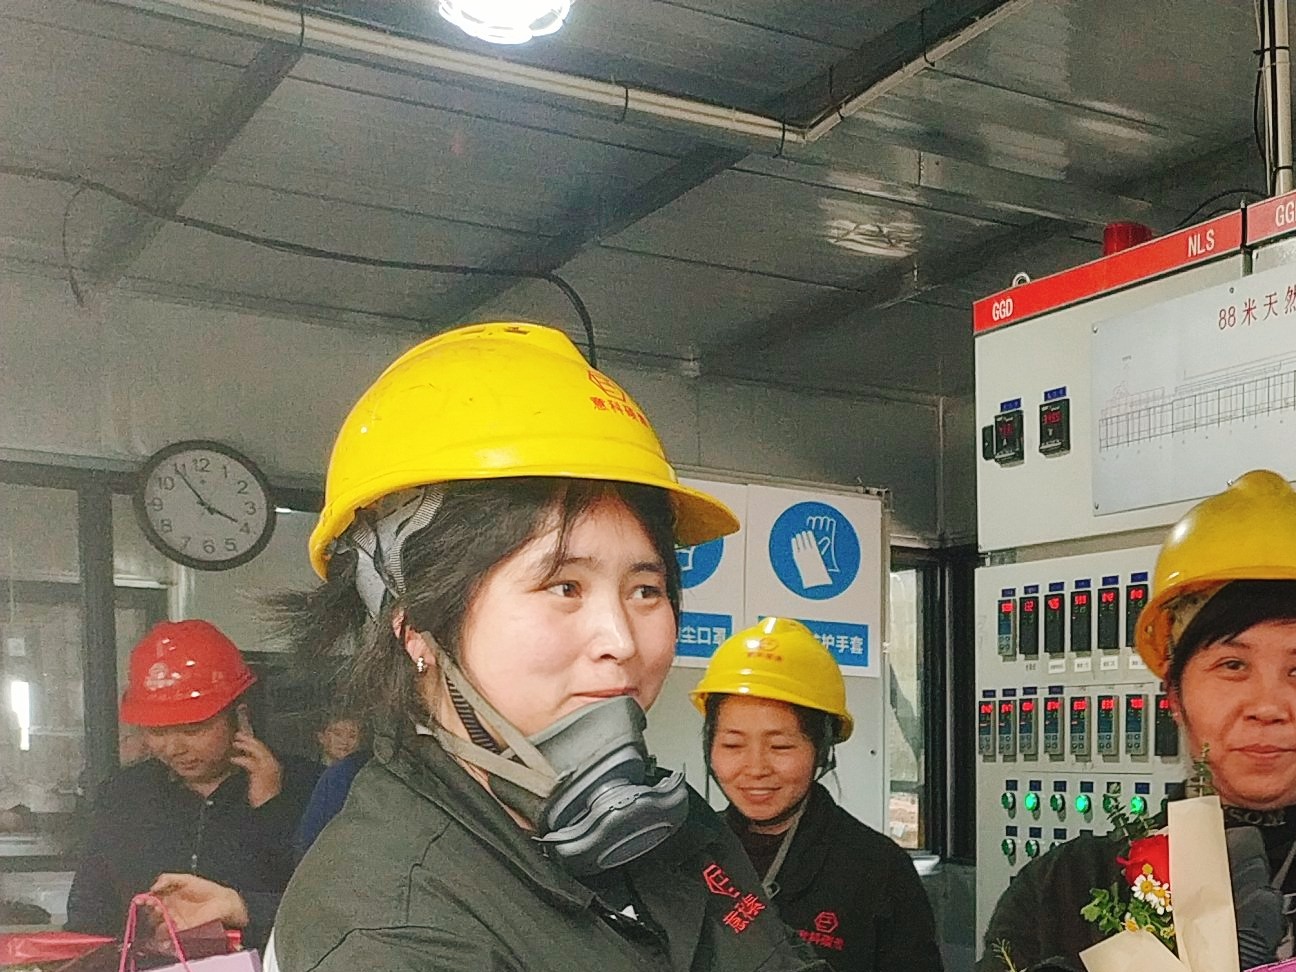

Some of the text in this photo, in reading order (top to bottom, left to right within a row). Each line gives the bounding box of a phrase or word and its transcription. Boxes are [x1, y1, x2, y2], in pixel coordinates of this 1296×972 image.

[1187, 229, 1215, 257] NLS
[991, 298, 1013, 322] GGD
[192, 458, 210, 472] 12
[159, 476, 175, 490] 10
[237, 481, 248, 494] 2
[244, 501, 256, 515] 3
[161, 519, 172, 533] 8
[240, 522, 250, 534] 4
[203, 540, 215, 554] 6
[225, 538, 237, 552] 5
[676, 625, 726, 645] 尘口罩
[814, 633, 863, 655] 护手套
